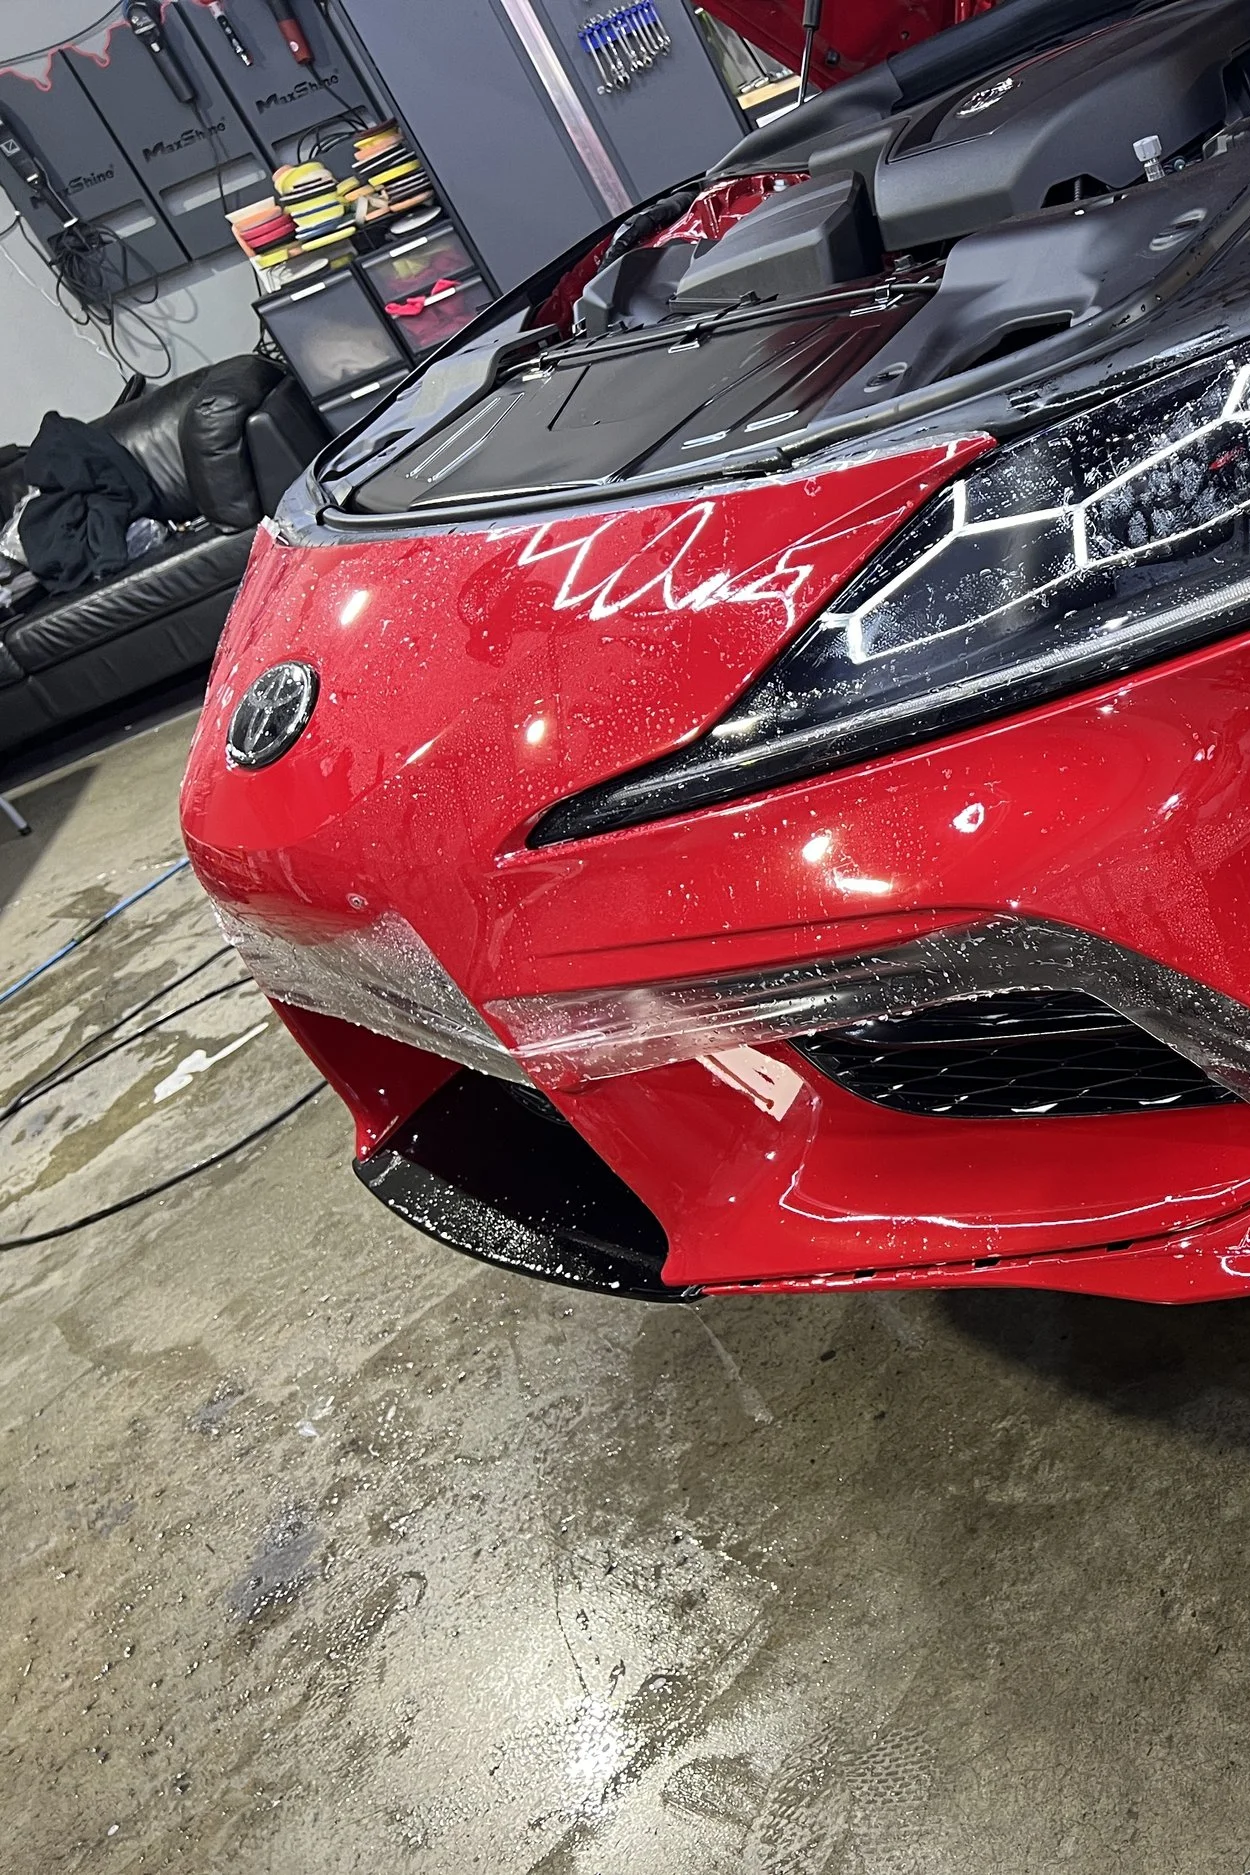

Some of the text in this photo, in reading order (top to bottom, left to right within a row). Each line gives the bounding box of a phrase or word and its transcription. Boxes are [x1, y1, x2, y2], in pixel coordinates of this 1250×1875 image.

[255, 73, 339, 115] MaxShne
[142, 121, 226, 162] MaxShne
[29, 167, 115, 210] MxShine
